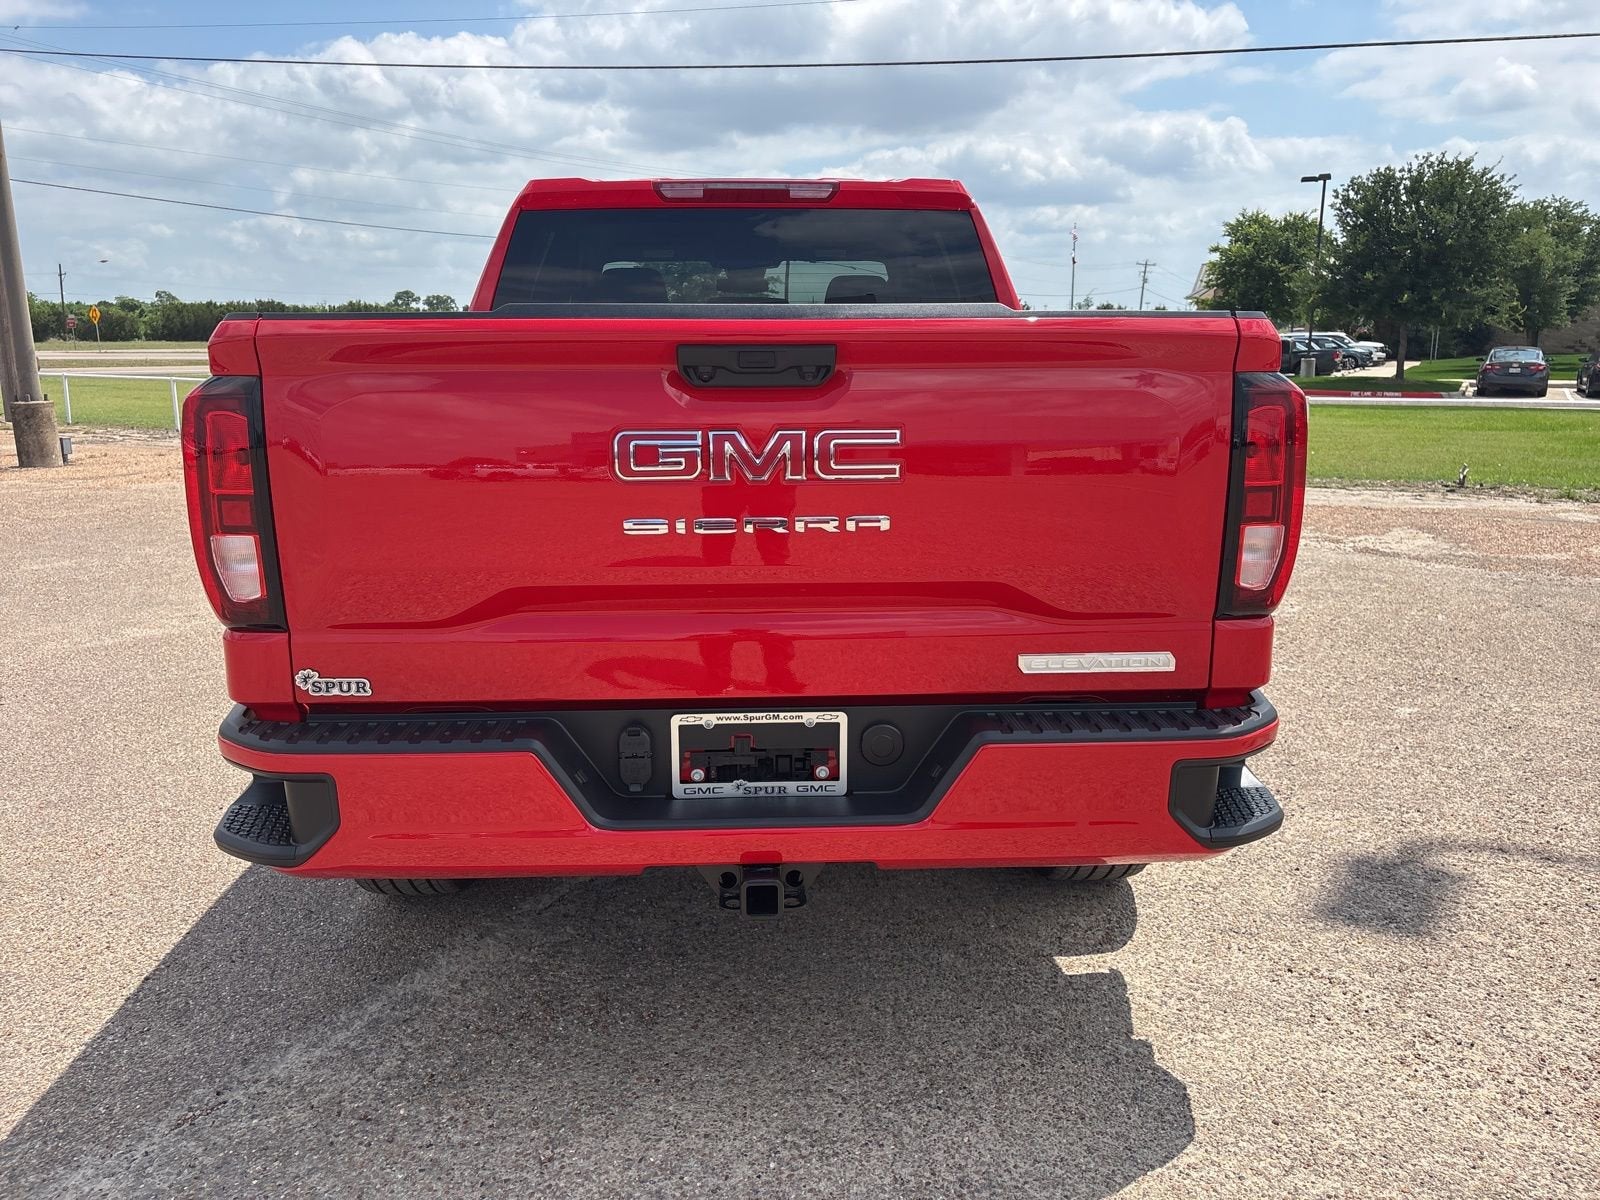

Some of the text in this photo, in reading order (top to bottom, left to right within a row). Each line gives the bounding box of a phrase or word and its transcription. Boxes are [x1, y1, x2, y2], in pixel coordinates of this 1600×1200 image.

[613, 429, 902, 482] GMC
[623, 515, 891, 535] SIERRA
[1030, 655, 1167, 670] ELEVATION
[311, 680, 368, 694] SPUR
[715, 713, 804, 723] www.SpurGM.com
[683, 784, 837, 795] GMC SPUR GMC
